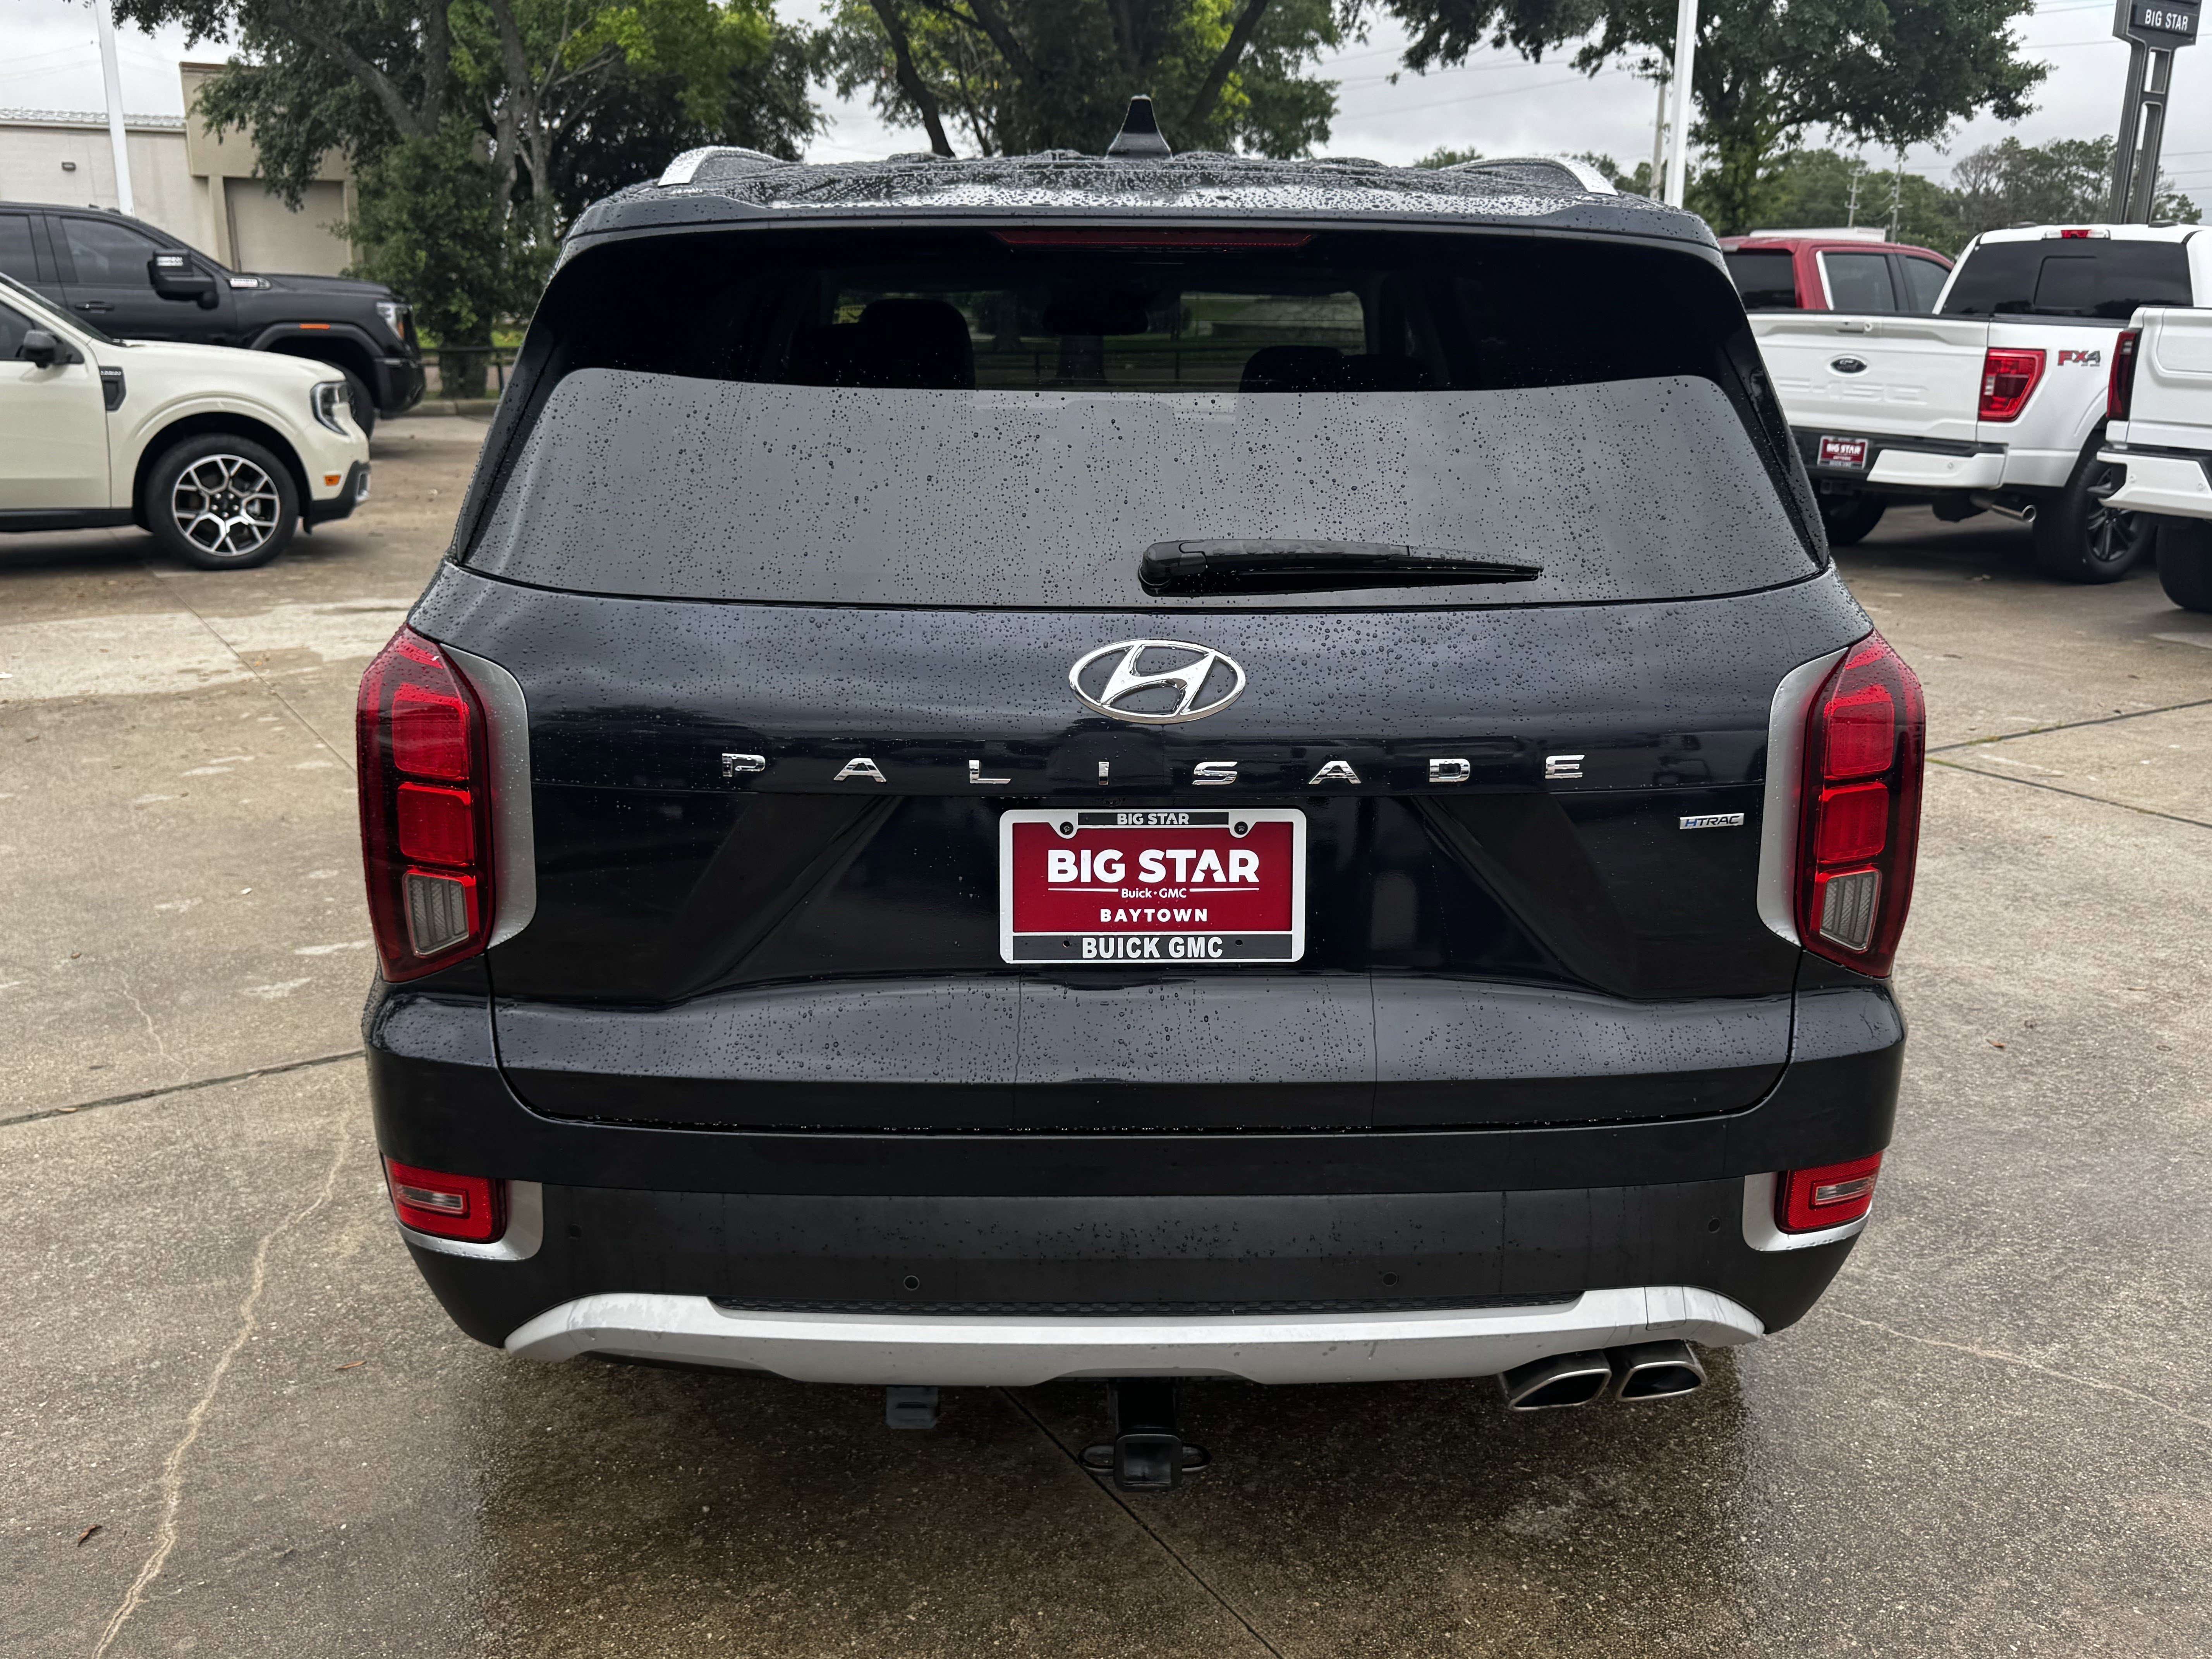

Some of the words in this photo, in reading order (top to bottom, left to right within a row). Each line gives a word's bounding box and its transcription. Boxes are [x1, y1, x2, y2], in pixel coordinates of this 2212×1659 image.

[2145, 9, 2162, 27] BIG
[2165, 12, 2188, 31] STAR
[2057, 350, 2101, 366] FX4
[722, 753, 1585, 785] PALISADE
[1117, 813, 1144, 825] BIG
[1148, 813, 1189, 825] STAR
[1685, 815, 1740, 827] HTRAC
[1048, 849, 1125, 883] BIG
[1138, 849, 1259, 883] STAR
[1100, 908, 1207, 922] BAYTOWN
[1082, 937, 1160, 958] BUICK
[1168, 936, 1223, 958] GMC
